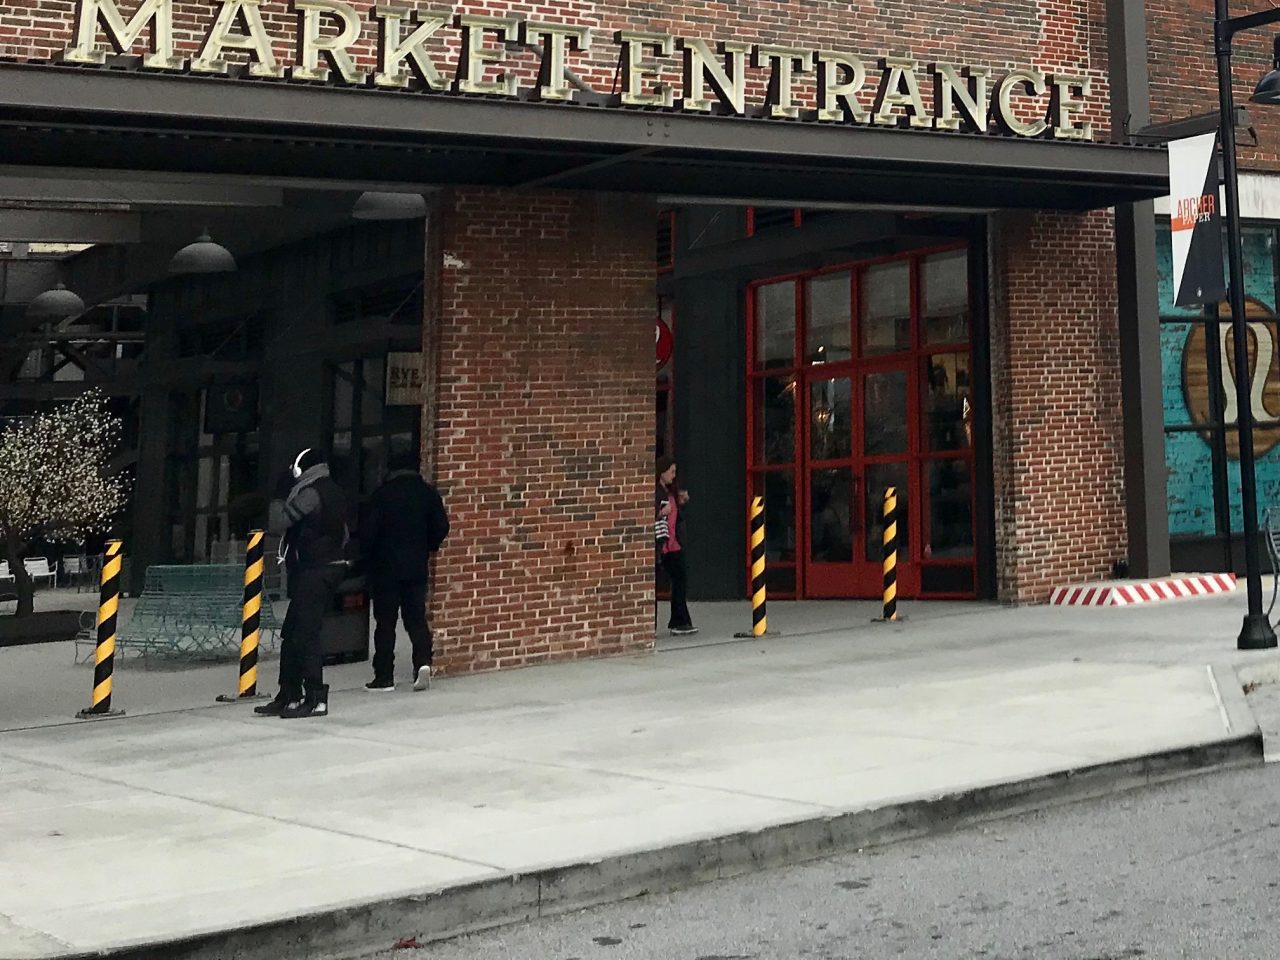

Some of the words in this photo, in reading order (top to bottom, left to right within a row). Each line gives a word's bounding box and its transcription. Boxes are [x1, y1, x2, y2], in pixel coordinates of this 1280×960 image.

[613, 29, 1093, 141] ENTRANCE
[1178, 194, 1215, 218] ARCHER
[1183, 211, 1211, 225] PAPER
